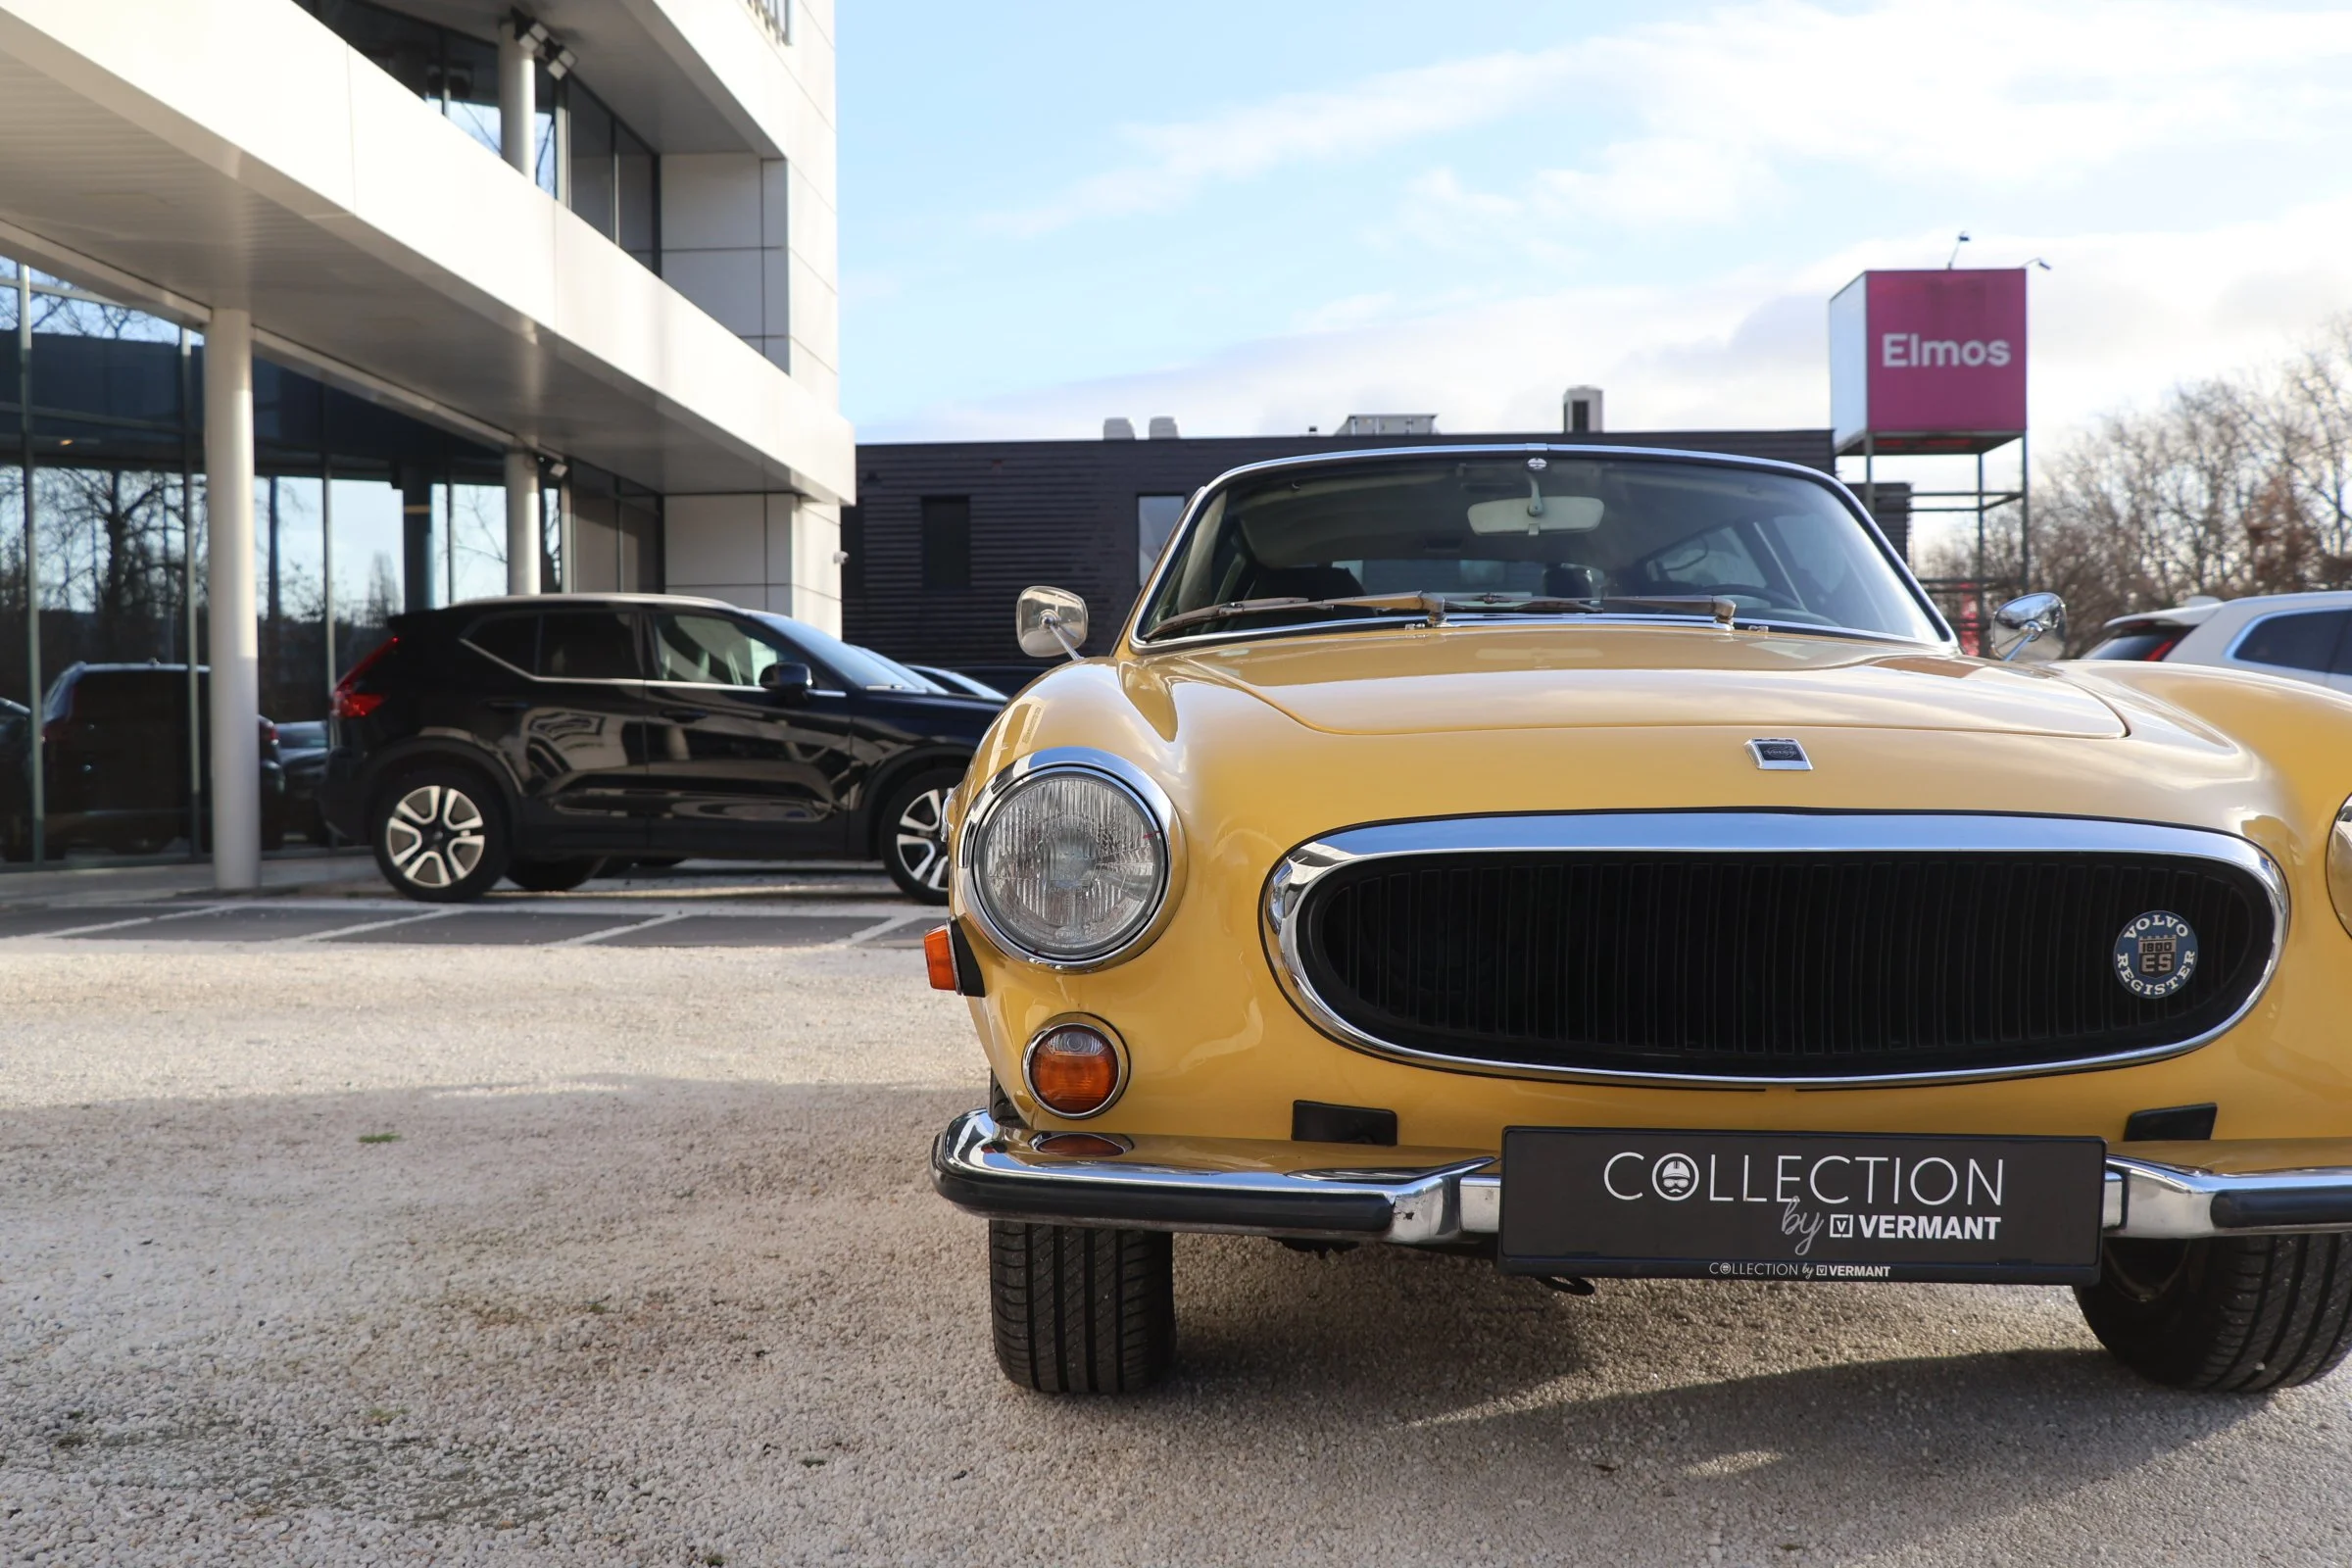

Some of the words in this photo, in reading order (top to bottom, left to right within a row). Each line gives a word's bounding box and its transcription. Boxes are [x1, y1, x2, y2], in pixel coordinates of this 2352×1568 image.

[1882, 333, 2011, 368] Elmos
[2124, 915, 2188, 939] VOLVO
[2142, 942, 2173, 953] 1800
[2117, 951, 2195, 996] REGISTER
[2141, 954, 2172, 972] ES
[1603, 1152, 2004, 1206] COLLECTION
[1781, 1196, 1825, 1255] by
[1859, 1214, 2002, 1240] VERMANT
[1709, 1262, 1798, 1275] COLLECTION
[1801, 1262, 1814, 1280] by
[1830, 1265, 1890, 1277] VERMANT
